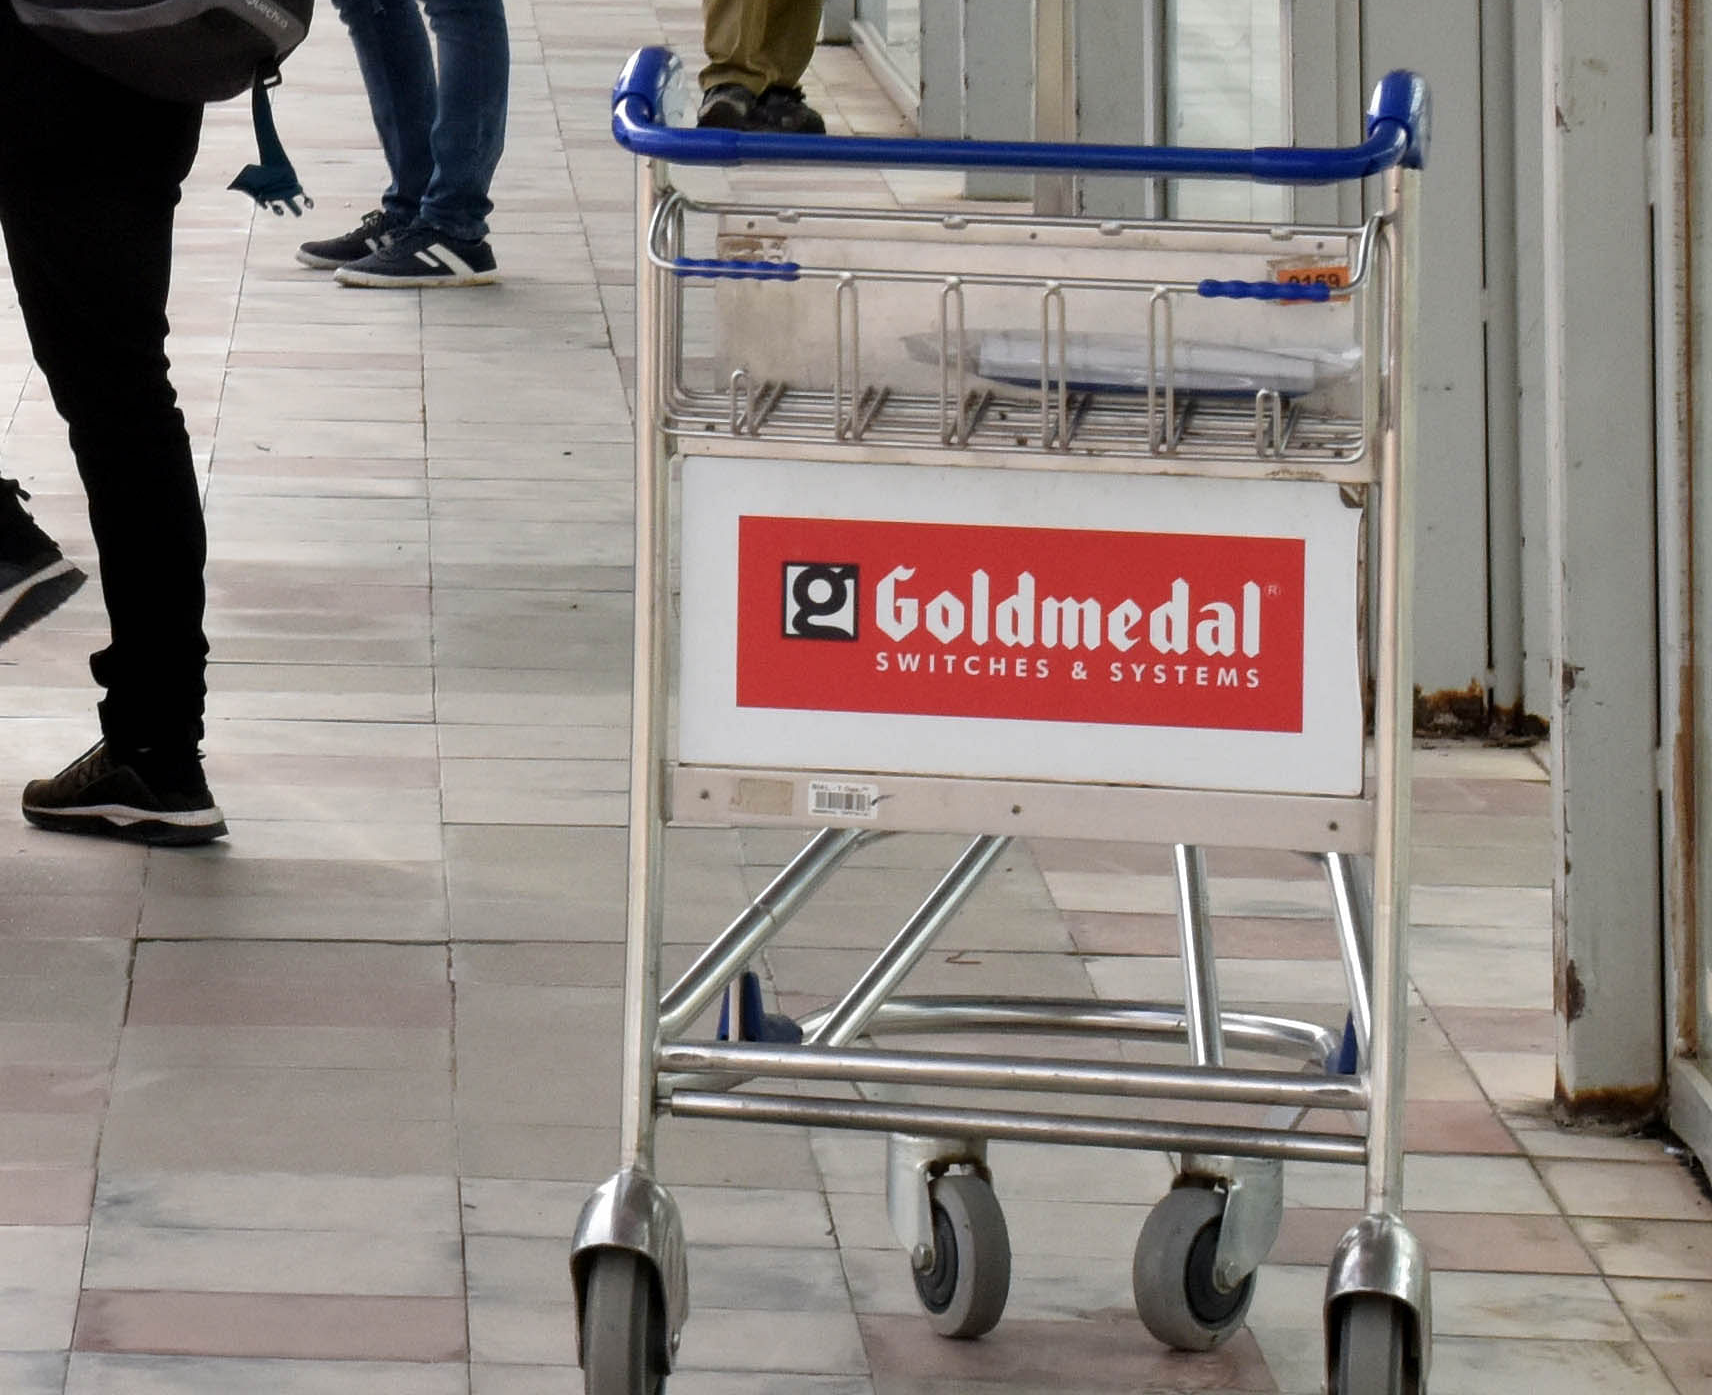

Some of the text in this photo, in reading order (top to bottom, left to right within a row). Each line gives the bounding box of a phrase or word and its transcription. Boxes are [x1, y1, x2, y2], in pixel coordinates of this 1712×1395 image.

[875, 564, 1261, 659] Goldmedal
[875, 651, 1261, 689] SWITCHES & SYSTEMS
